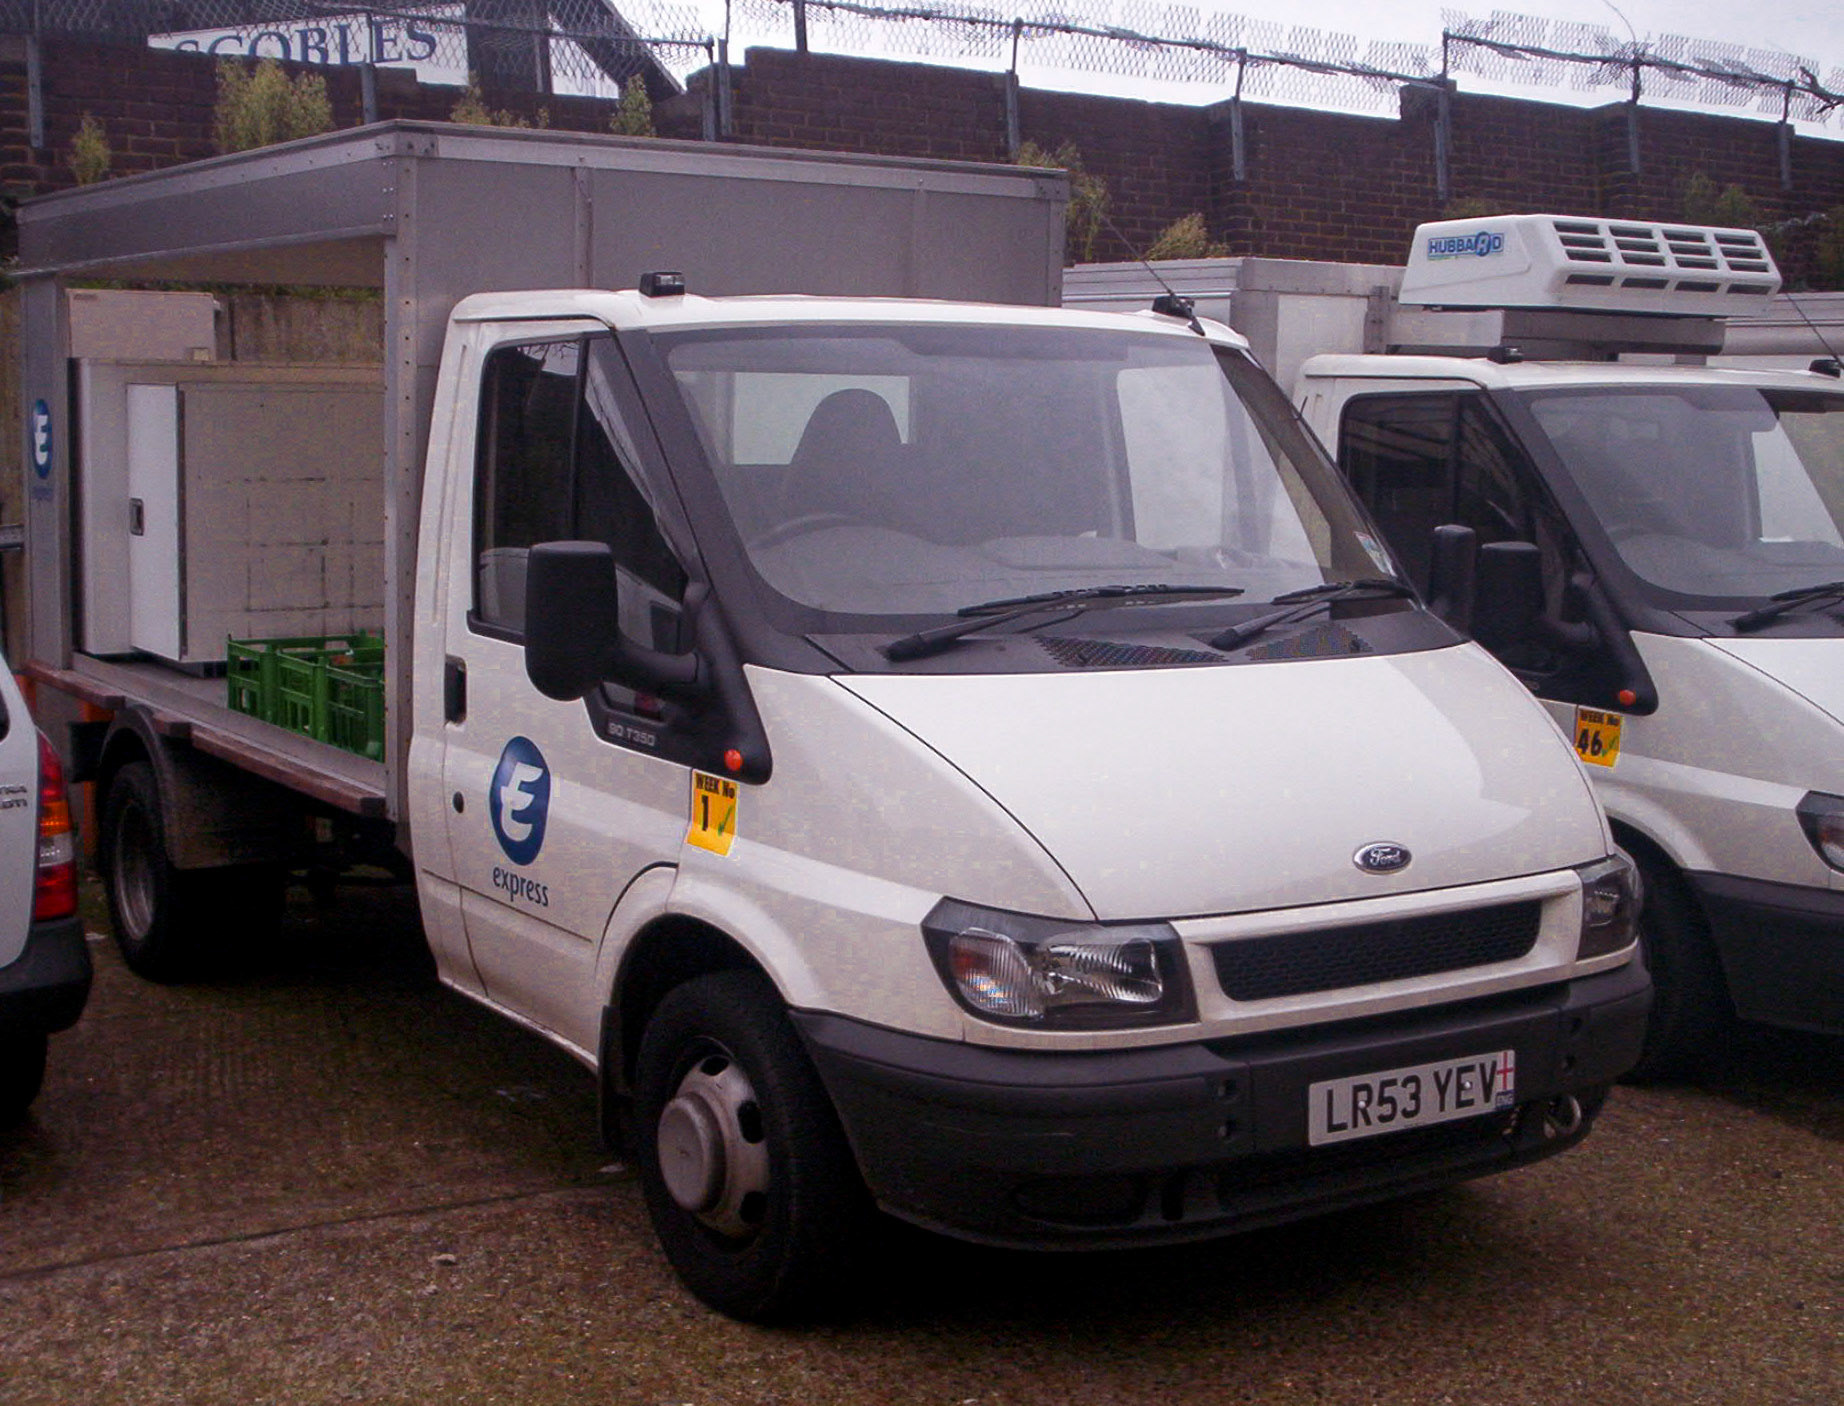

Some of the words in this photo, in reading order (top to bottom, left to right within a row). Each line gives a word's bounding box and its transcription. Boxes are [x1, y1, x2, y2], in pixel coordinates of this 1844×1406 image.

[1429, 232, 1502, 257] HUBBARD
[1577, 728, 1603, 757] 46
[696, 773, 720, 795] WEEK
[702, 795, 710, 833] 1
[1369, 846, 1401, 867] Ford
[492, 866, 549, 907] express
[1326, 1074, 1421, 1133] LR53
[1433, 1060, 1498, 1113] YEV
